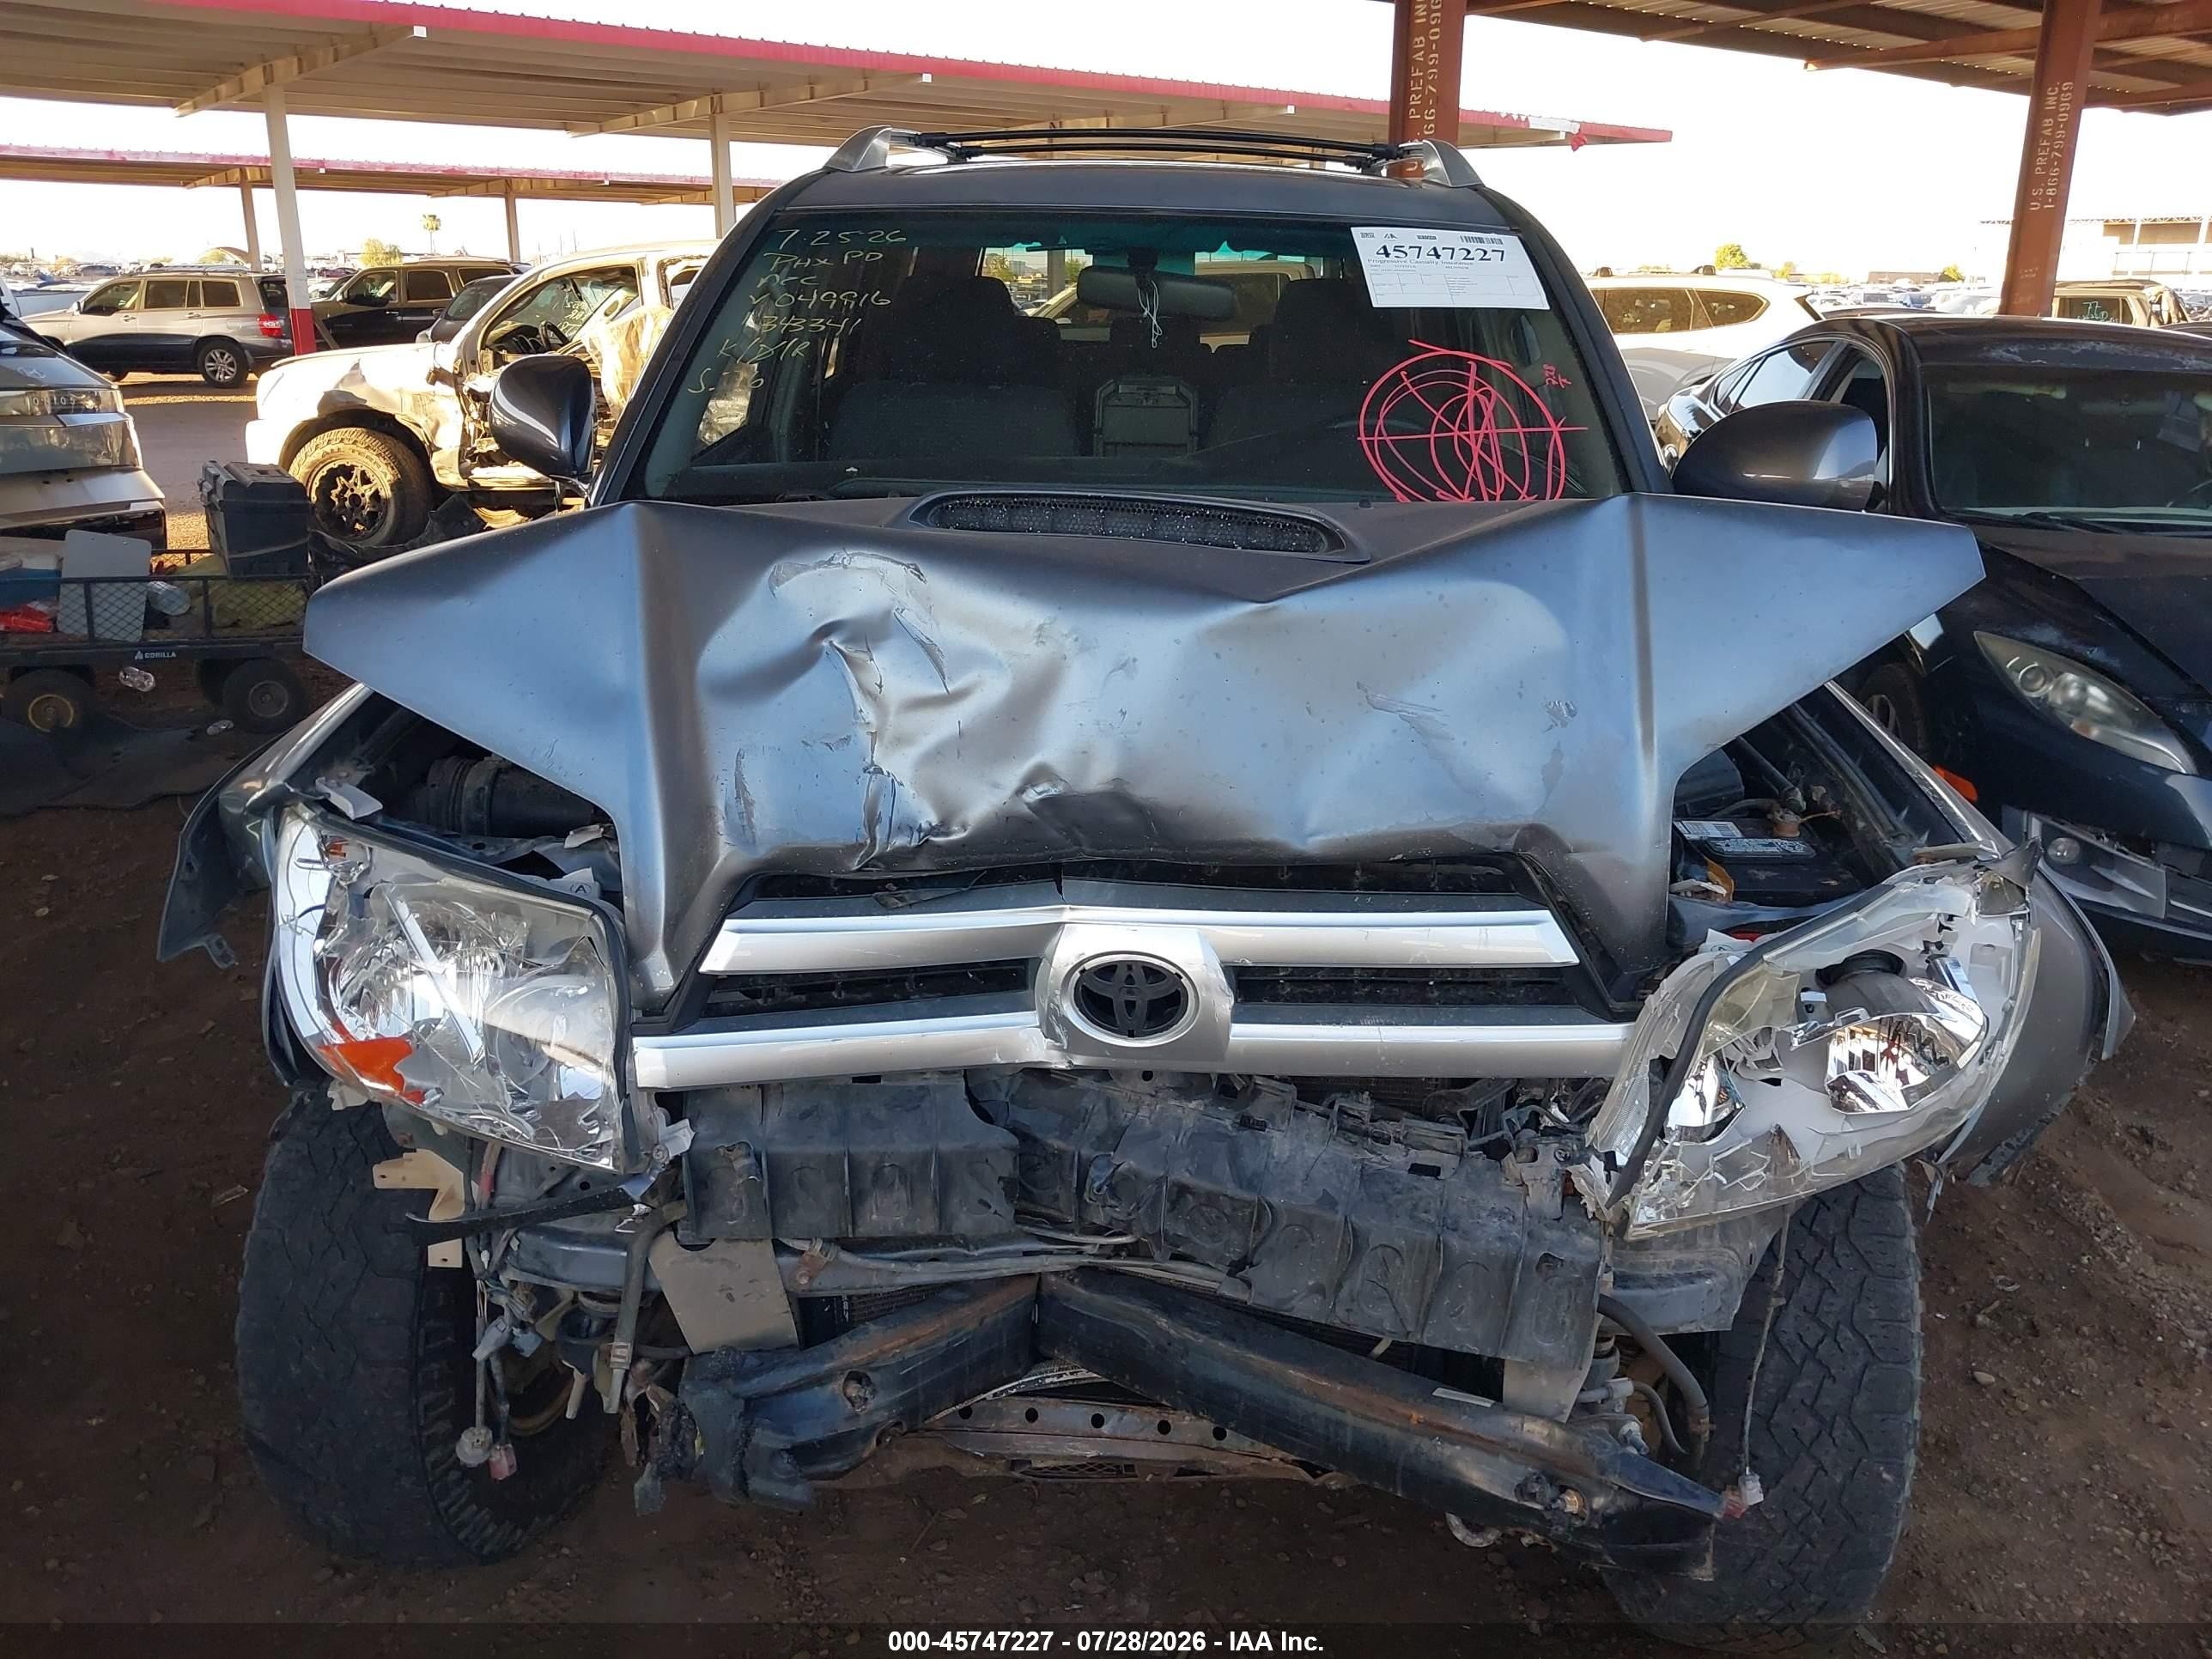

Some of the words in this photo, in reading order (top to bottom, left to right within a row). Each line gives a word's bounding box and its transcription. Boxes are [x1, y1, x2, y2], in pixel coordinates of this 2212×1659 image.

[1414, 0, 1427, 23] IN
[1408, 35, 1425, 119] PREFAB
[2045, 82, 2061, 110] INC.
[2034, 118, 2054, 174] PREFAB
[2043, 82, 2074, 210] 1-866-799-0969
[2029, 183, 2045, 210] U.S.
[843, 250, 884, 265] PD
[1376, 244, 1505, 262] 45747227
